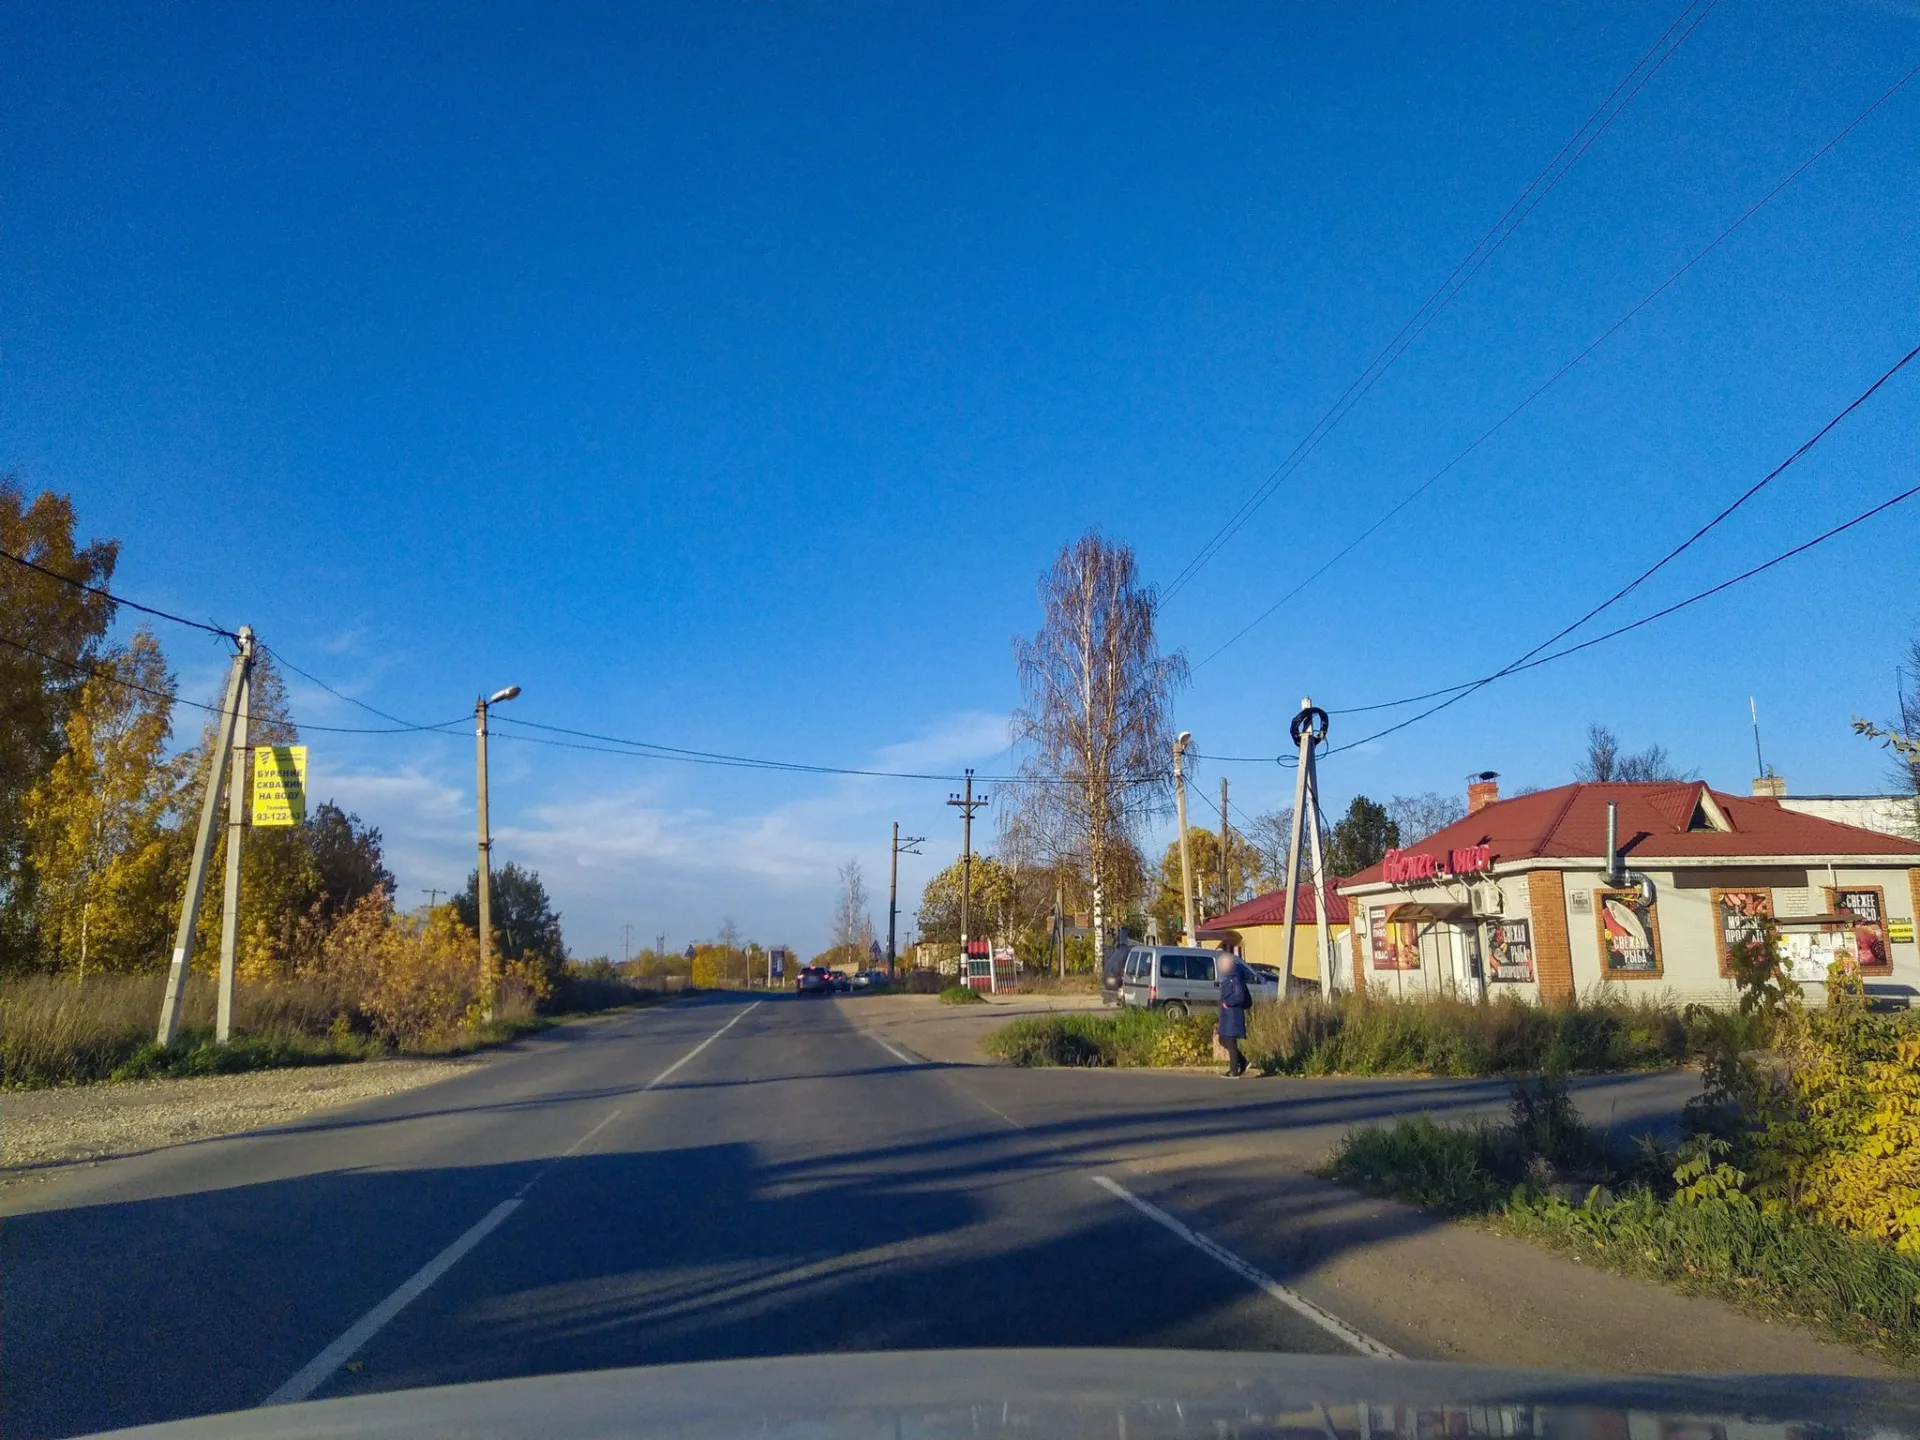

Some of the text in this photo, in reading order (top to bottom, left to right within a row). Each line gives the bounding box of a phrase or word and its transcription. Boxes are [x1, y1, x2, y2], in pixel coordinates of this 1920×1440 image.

[257, 769, 302, 778] БУРЕНИЕ
[256, 780, 303, 789] СКВАЖИН
[258, 791, 299, 800] НА ВОДУ
[1846, 894, 1875, 907] СВЕЖЕЕ
[1613, 935, 1645, 950] СВЕЖАЯ
[1624, 949, 1647, 964] РЫБА
